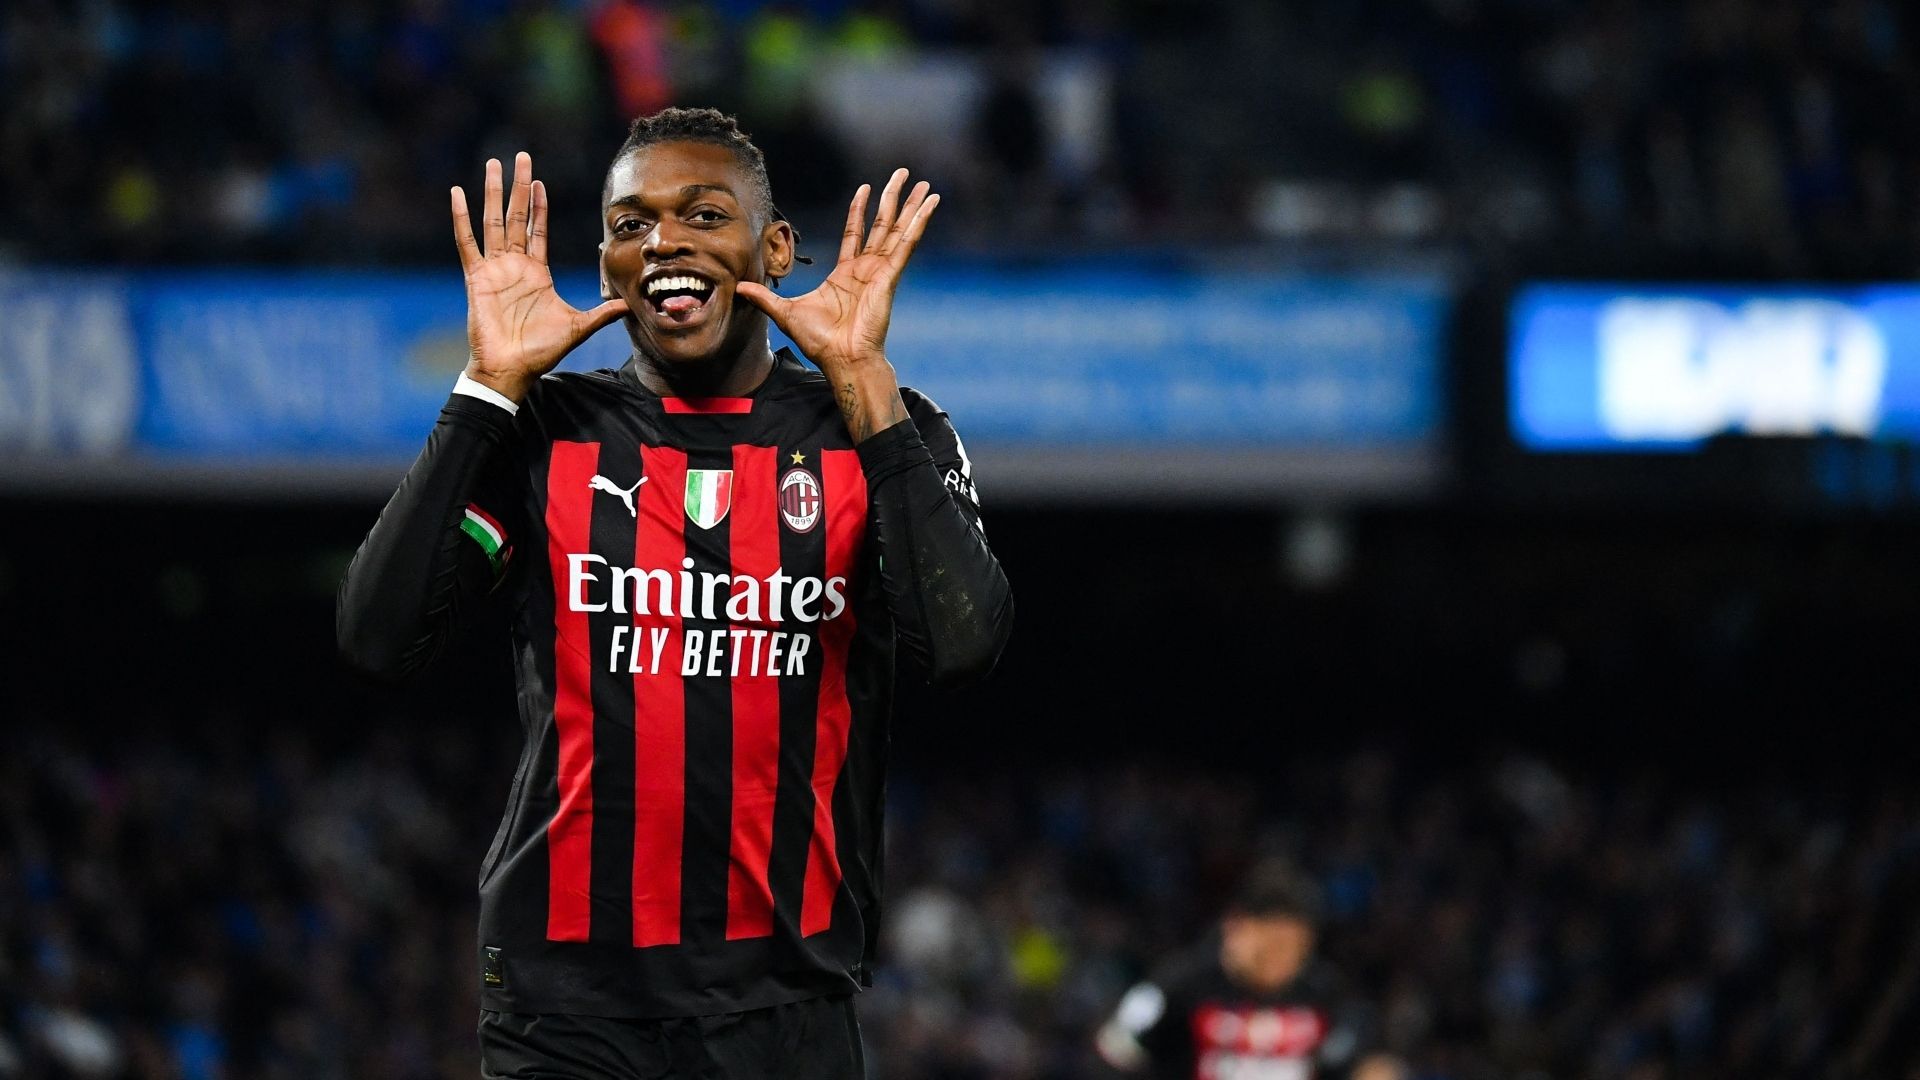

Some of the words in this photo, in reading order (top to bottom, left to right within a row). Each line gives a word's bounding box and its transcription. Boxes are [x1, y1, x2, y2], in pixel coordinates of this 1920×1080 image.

[787, 472, 811, 484] ACM
[566, 553, 847, 623] Emirates
[609, 625, 670, 674] FLY
[681, 629, 811, 677] BETTER
